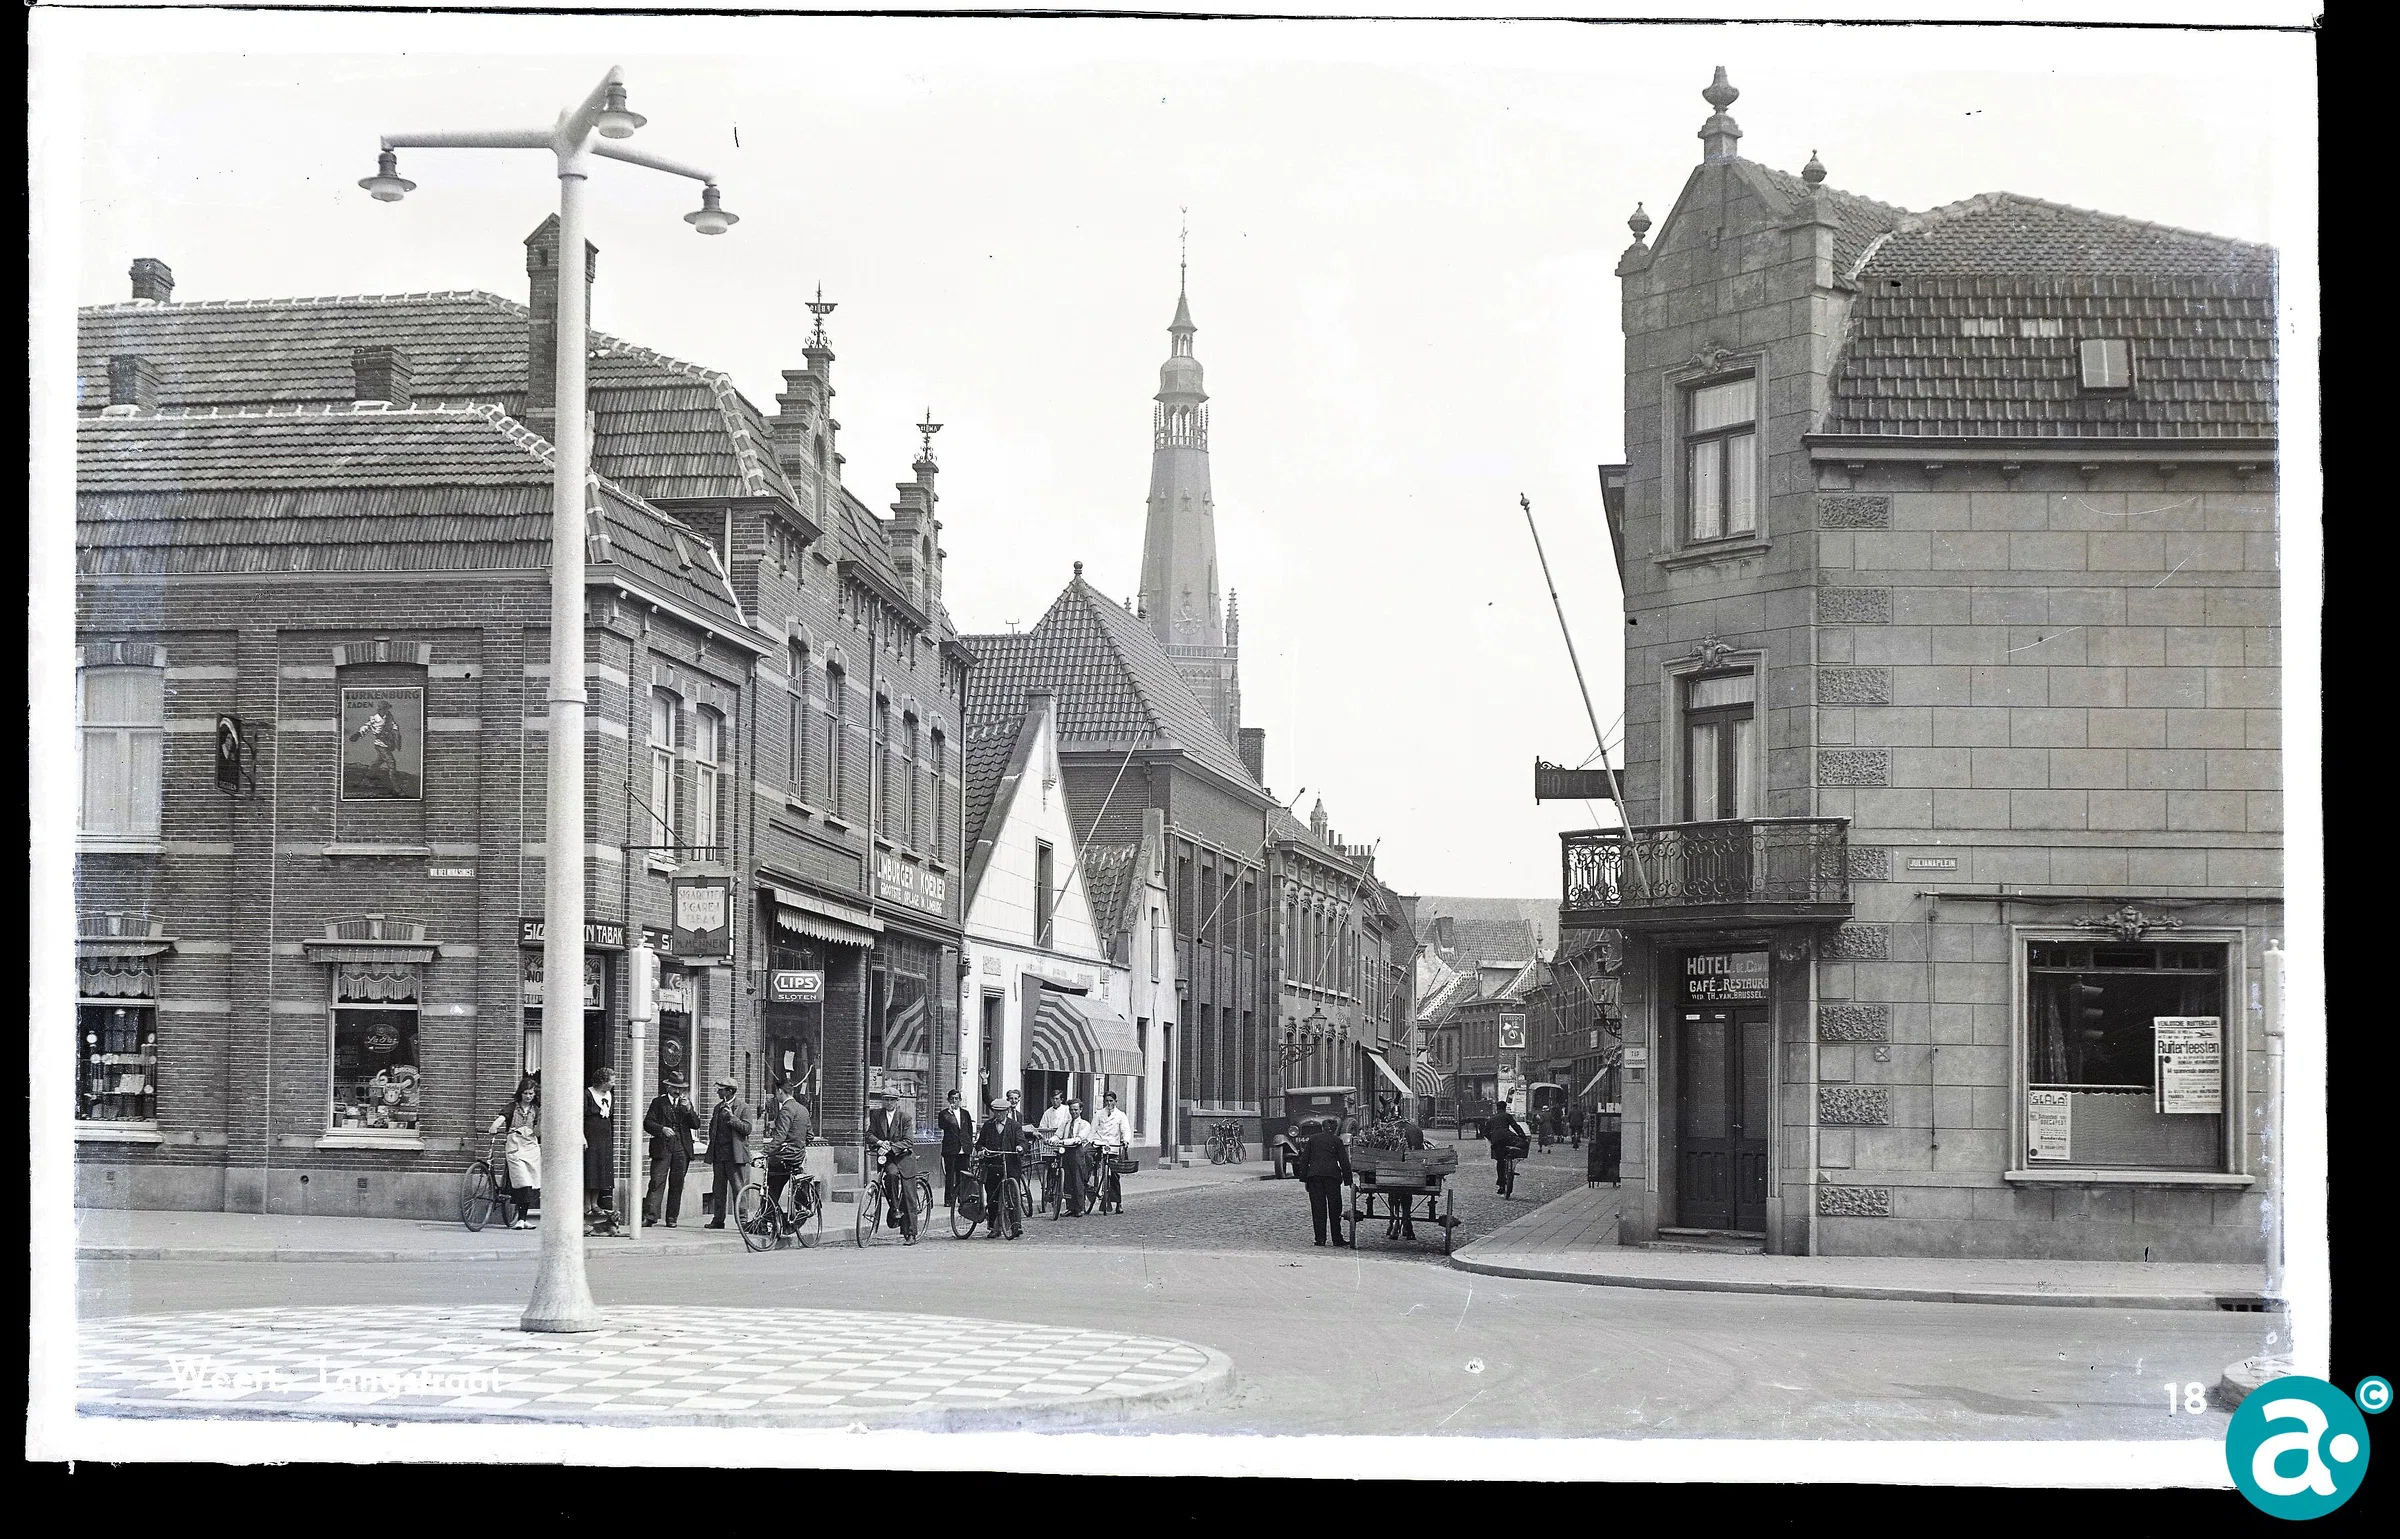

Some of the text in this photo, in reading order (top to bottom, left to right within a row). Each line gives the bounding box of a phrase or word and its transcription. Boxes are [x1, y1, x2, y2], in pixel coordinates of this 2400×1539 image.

[347, 701, 373, 709] ZADEN
[1909, 859, 1956, 867] JULIANAPLEIN
[596, 925, 623, 944] TABAK
[1687, 955, 1731, 975] HÔTEL
[780, 977, 814, 988] LIPS
[2158, 1040, 2220, 1054] Ruiterfeesten
